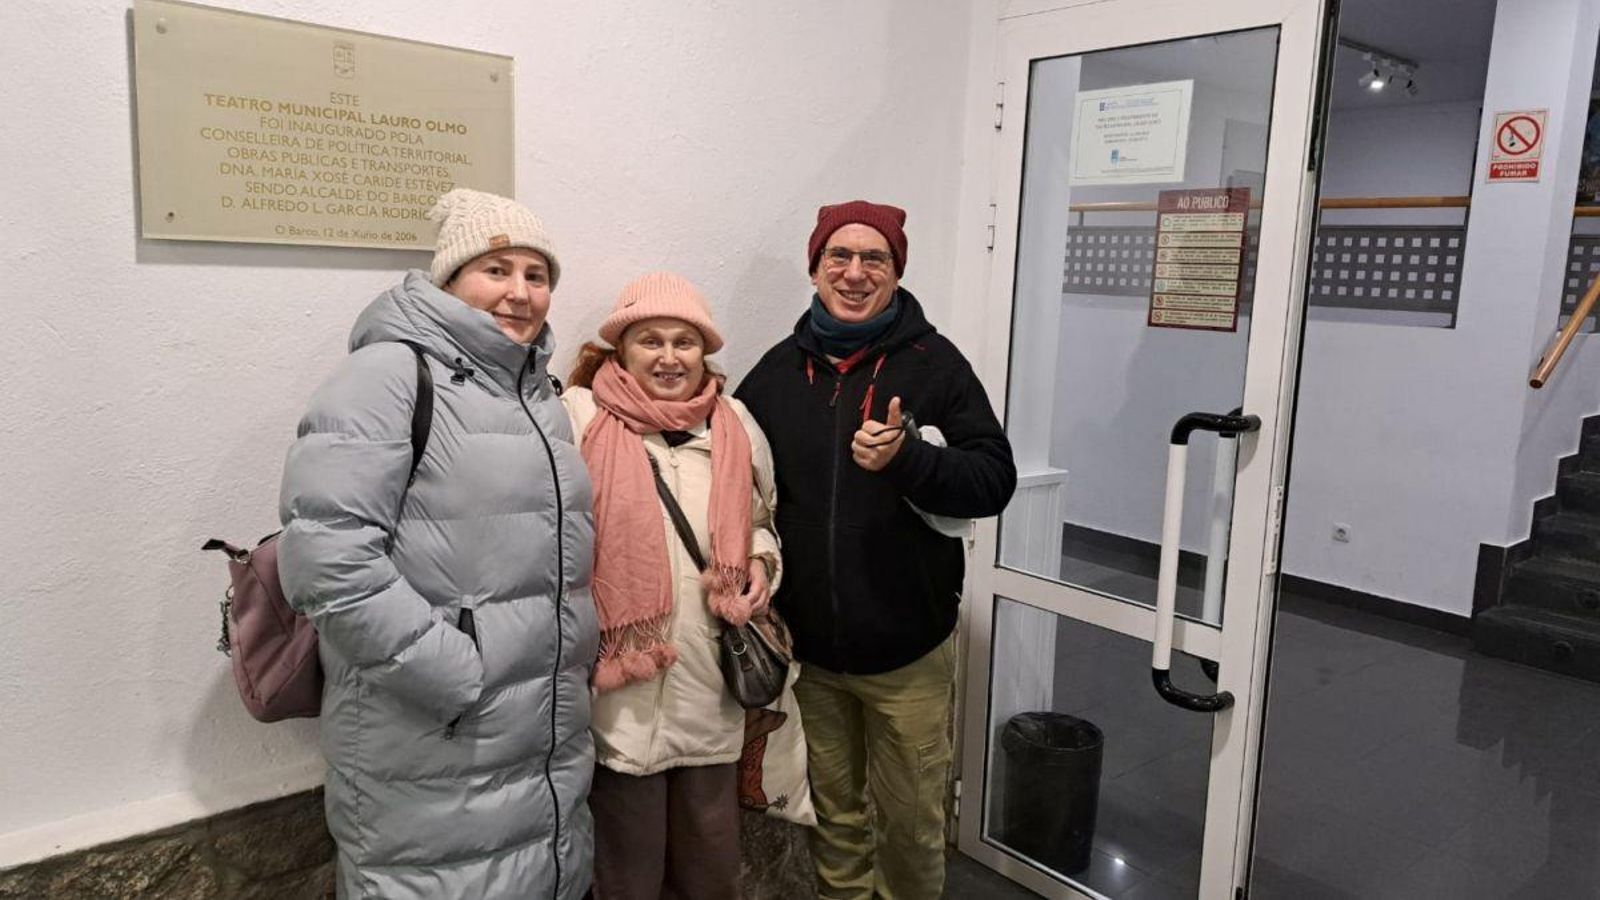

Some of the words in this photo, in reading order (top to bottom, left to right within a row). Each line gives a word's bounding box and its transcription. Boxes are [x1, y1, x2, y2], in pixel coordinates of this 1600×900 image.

[329, 91, 360, 106] ESTE
[203, 93, 273, 112] TEATRO
[278, 102, 366, 123] MUNICIPAL
[371, 113, 421, 129] LAURO
[425, 120, 467, 135] OLMO
[200, 127, 301, 148] CONSELLEIRA
[306, 137, 324, 151] DE
[260, 116, 284, 129] FOI
[288, 120, 386, 141] INAUGURADO
[390, 131, 424, 145] POLA
[227, 146, 277, 163] OBRAS
[351, 158, 359, 169] E
[353, 174, 401, 189] CARIDE
[245, 181, 297, 196] SENDO
[301, 186, 362, 201] ALCALDE
[367, 190, 388, 203] DO
[221, 196, 235, 209] D.
[241, 198, 308, 213] ALFREDO
[1177, 196, 1190, 210] AO
[275, 225, 285, 235] O
[324, 227, 334, 238] 12
[337, 228, 349, 238] de
[381, 231, 392, 240] de
[395, 230, 417, 241] 2006
